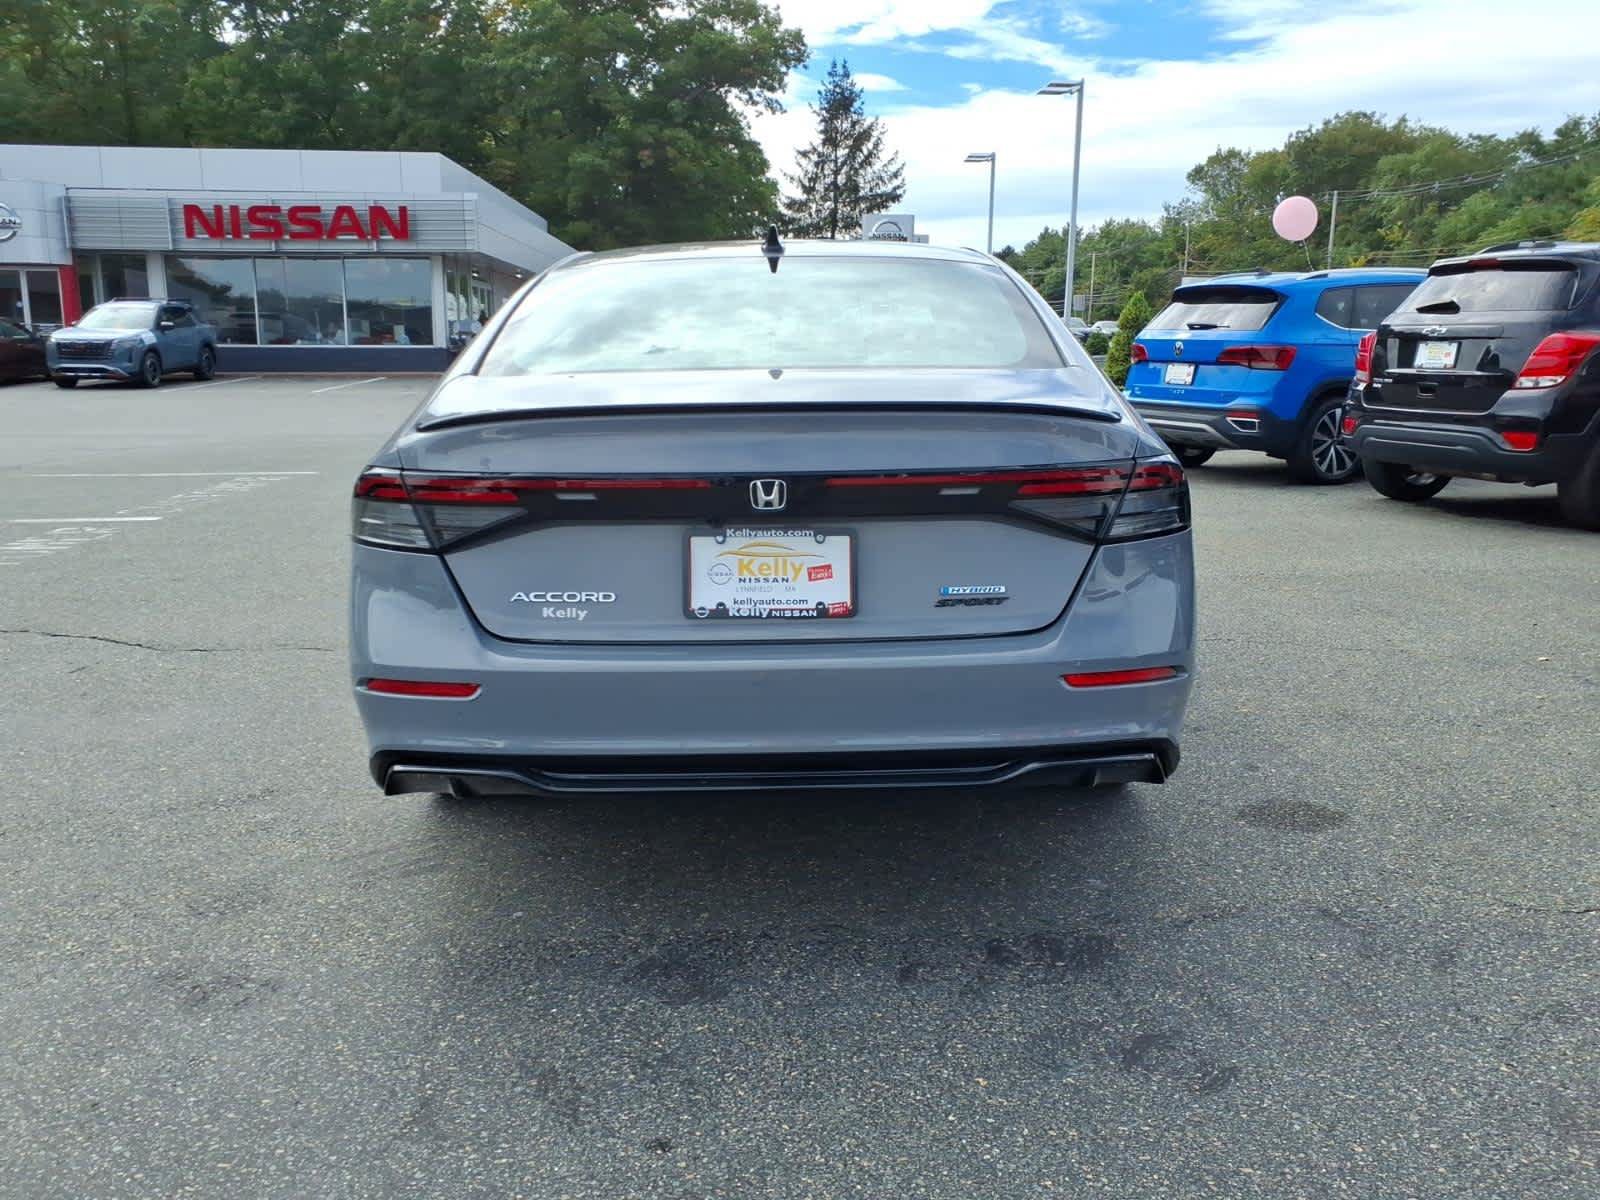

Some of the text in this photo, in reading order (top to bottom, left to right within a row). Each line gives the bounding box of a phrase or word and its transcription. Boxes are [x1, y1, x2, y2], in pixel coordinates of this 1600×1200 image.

[183, 204, 409, 240] NISSAN
[726, 528, 814, 538] Kellyauto.com
[737, 558, 804, 583] Kelly
[949, 586, 1006, 594] HYBRID
[510, 592, 616, 602] ACCORD
[733, 597, 808, 607] kellyauto.com
[542, 607, 588, 621] Kelly
[729, 606, 817, 618] Kelly NISSAN
